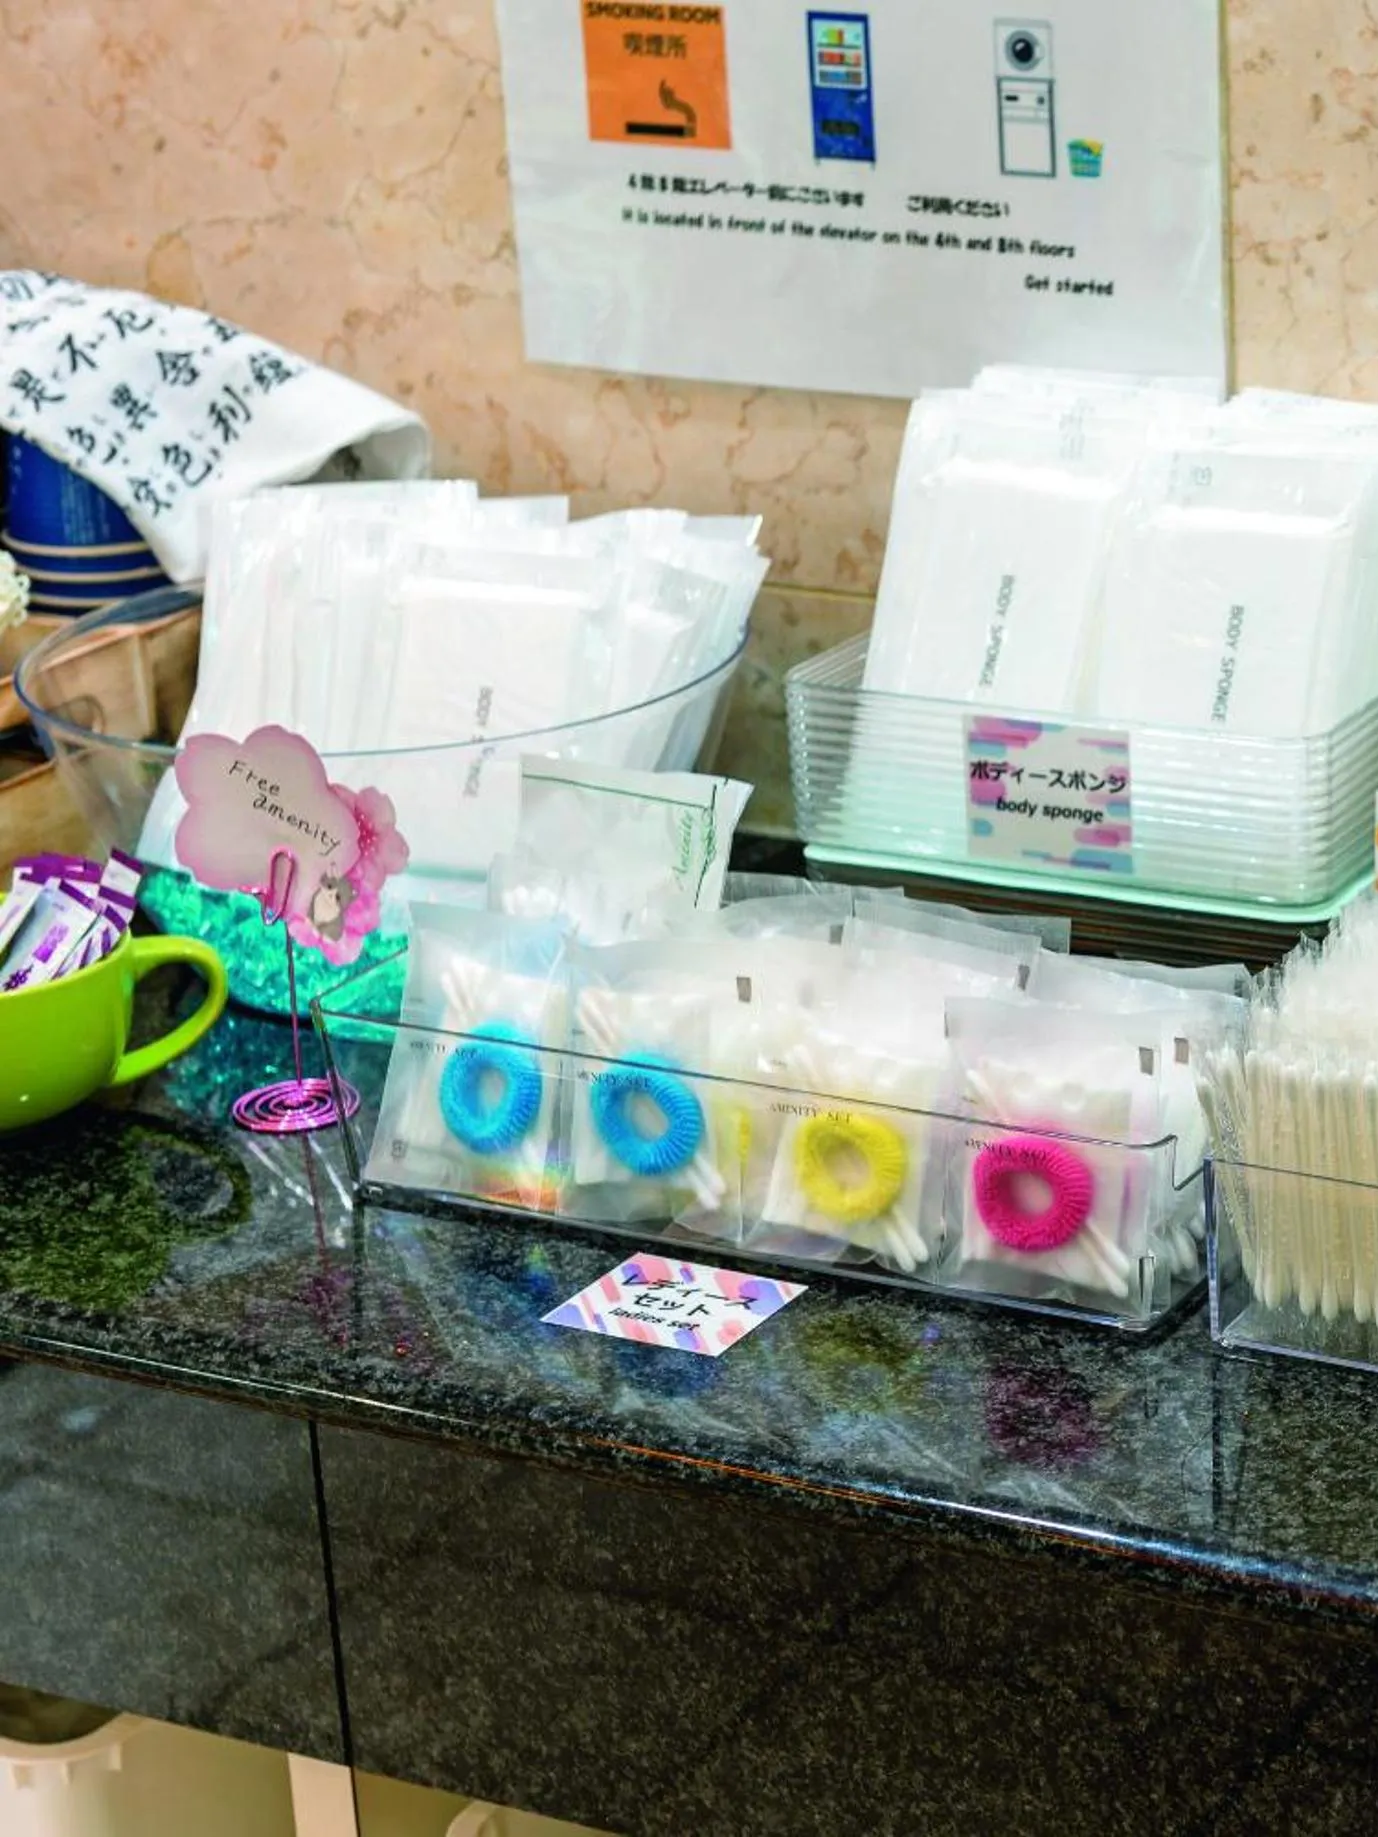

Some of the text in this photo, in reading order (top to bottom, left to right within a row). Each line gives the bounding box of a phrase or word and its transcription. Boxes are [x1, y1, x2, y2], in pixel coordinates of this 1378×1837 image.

[586, 1, 722, 24] SMOKING ROOM
[622, 31, 688, 59] 喫煙所
[653, 210, 704, 229] located
[708, 213, 723, 230] in
[727, 215, 766, 232] front
[770, 219, 786, 235] of
[791, 221, 814, 237] the
[820, 221, 878, 242] elevator
[882, 230, 901, 244] on
[905, 230, 929, 247] the
[966, 235, 993, 252] and
[1029, 239, 1076, 259] floors
[1024, 273, 1115, 297] Get started
[978, 574, 1016, 688] BODY SPONGE
[1210, 604, 1245, 723] BODY SPONGE
[228, 759, 281, 797] Free
[969, 759, 1129, 794] ボディースポンジ
[252, 792, 342, 857] amenity
[995, 796, 1104, 825] body sponge
[622, 1273, 760, 1311] レディース
[633, 1292, 711, 1317] セット
